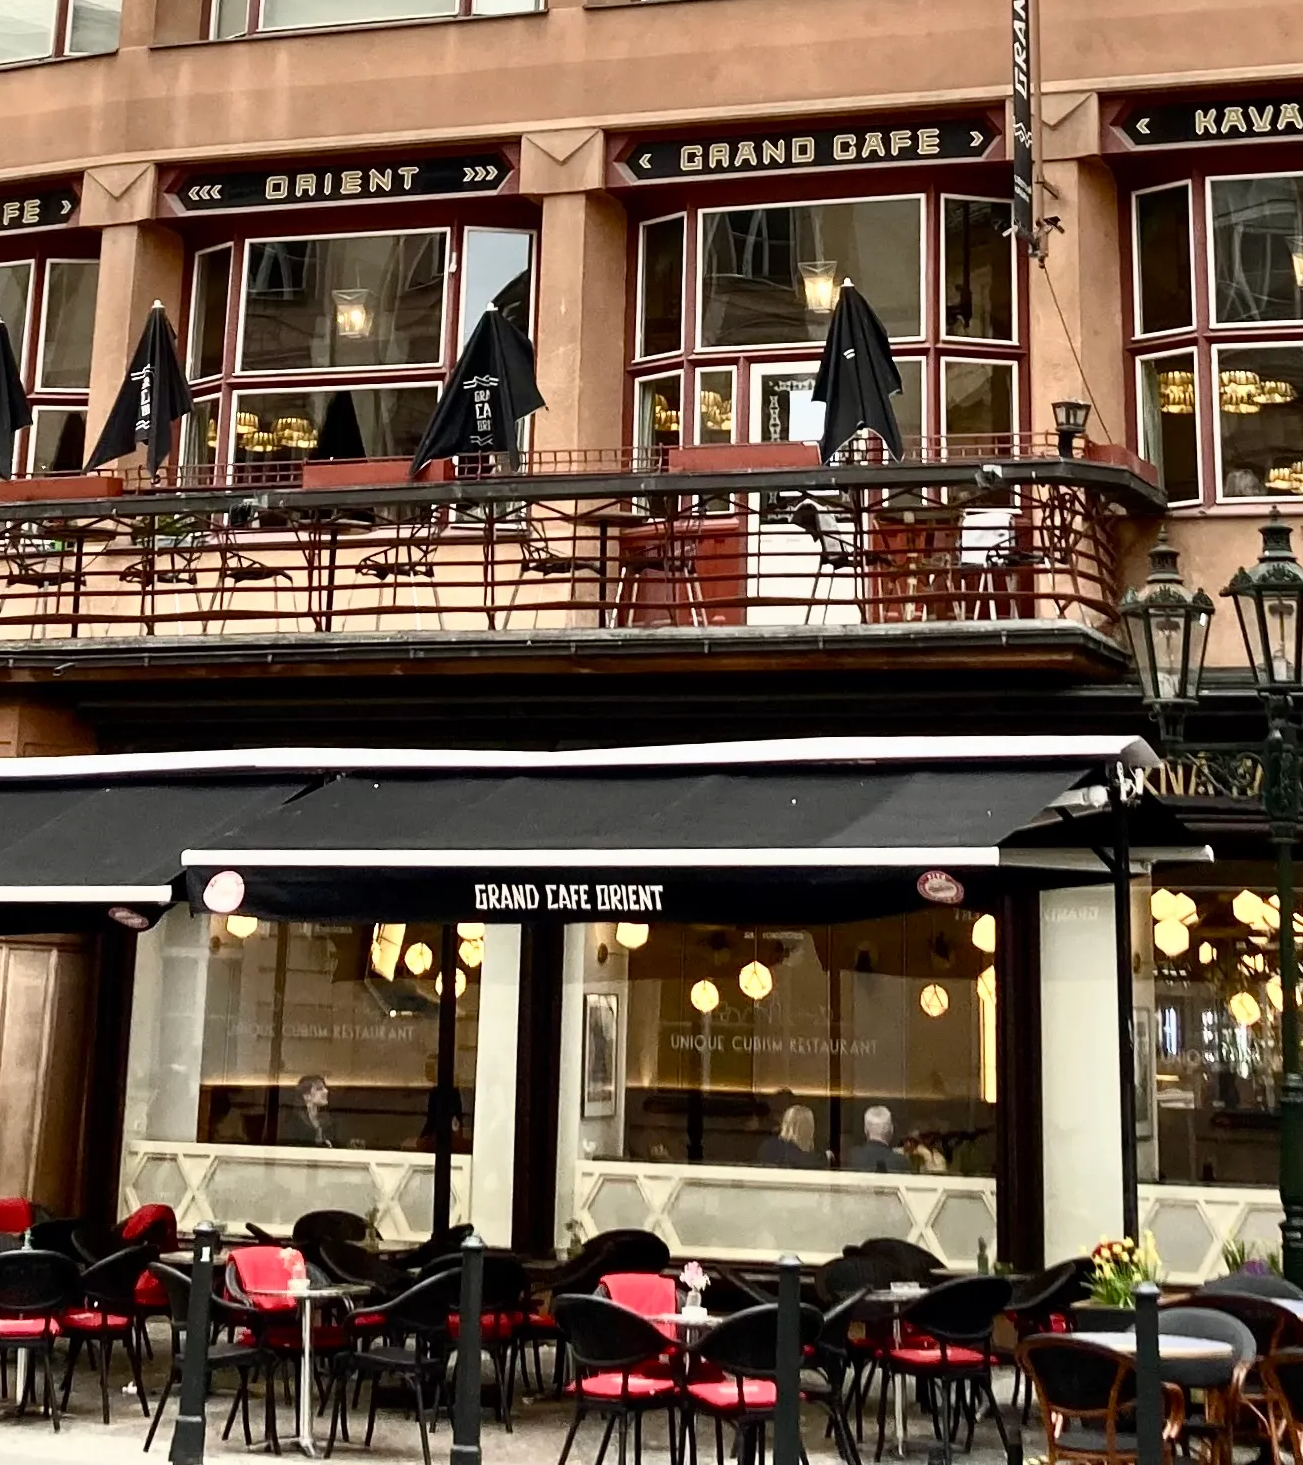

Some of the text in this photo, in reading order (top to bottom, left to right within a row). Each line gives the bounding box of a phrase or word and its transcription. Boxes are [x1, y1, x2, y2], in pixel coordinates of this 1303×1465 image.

[680, 128, 940, 171] GRAND CAFE
[265, 166, 419, 200] ORIENT
[474, 883, 665, 912] GRAND CAFE ORIENT
[670, 1034, 878, 1056] UNIQUE CUBISM RESTAURANT
